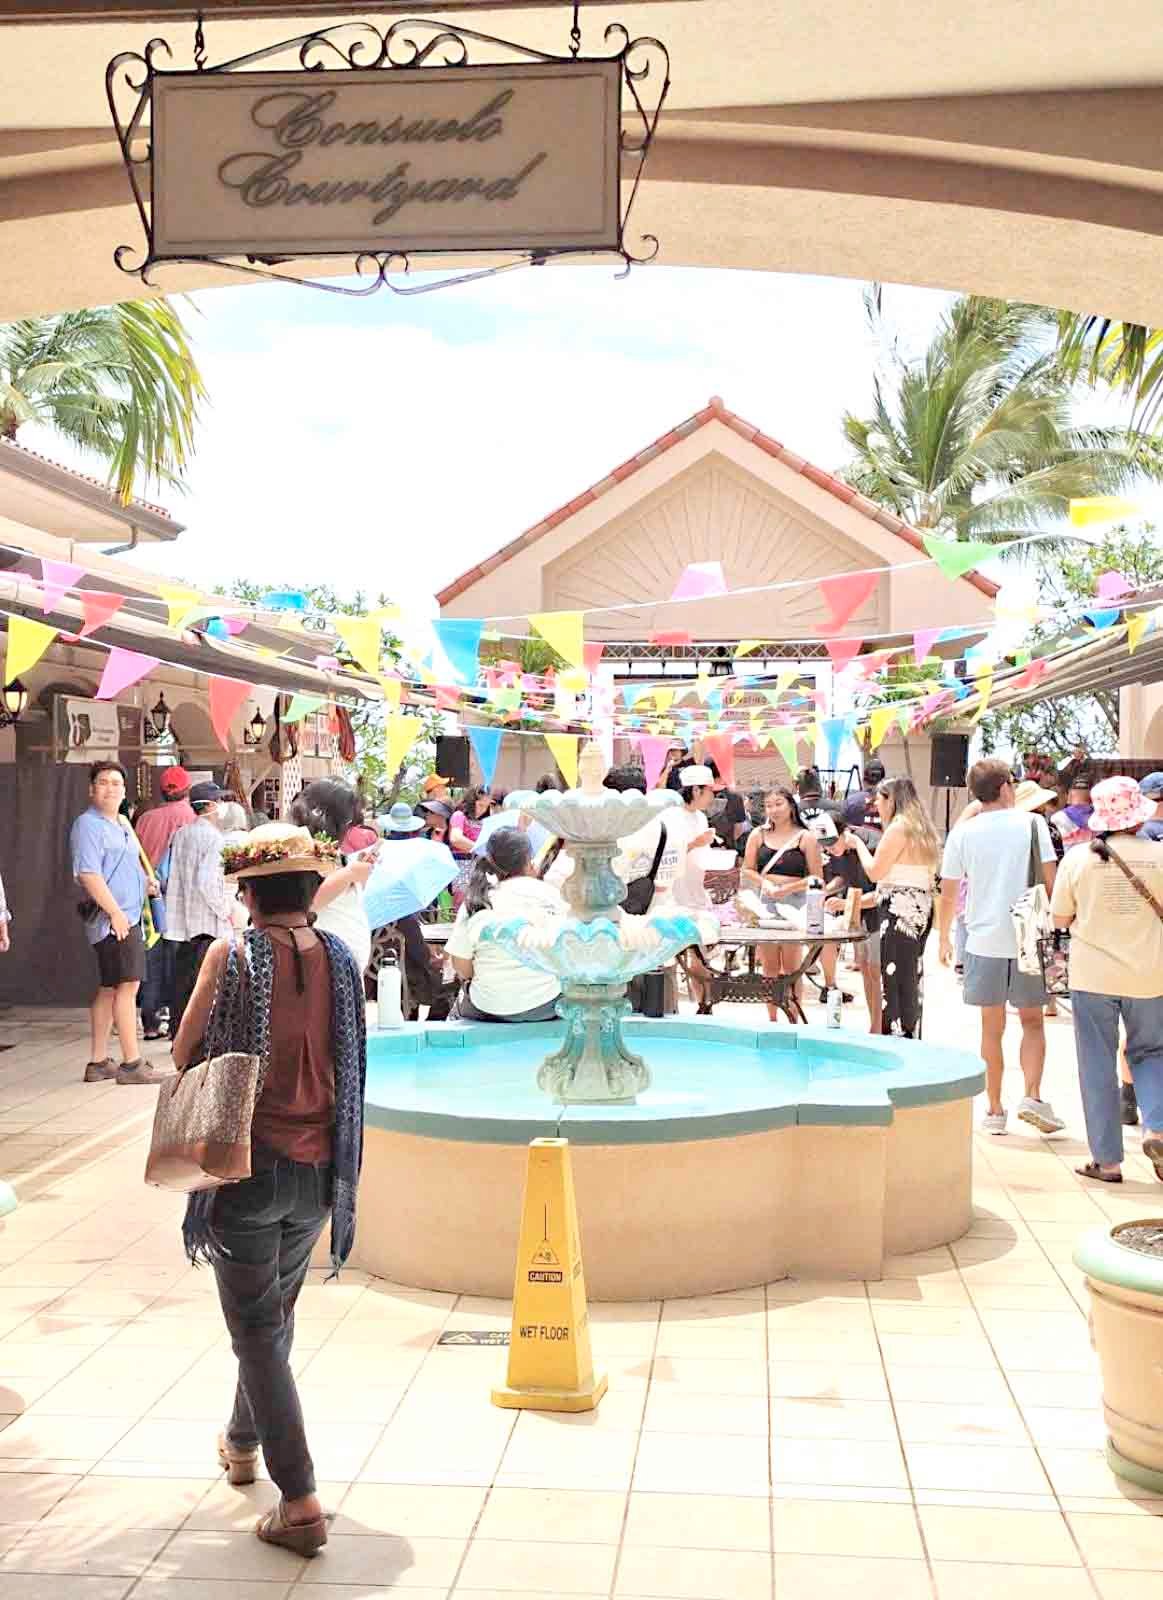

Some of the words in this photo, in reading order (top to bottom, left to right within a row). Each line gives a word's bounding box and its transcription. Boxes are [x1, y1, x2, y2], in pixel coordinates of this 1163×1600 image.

[250, 88, 514, 150] Consuelo
[217, 151, 548, 226] Courtyard
[529, 1272, 562, 1282] CAUTION
[519, 1325, 538, 1339] WET
[540, 1325, 569, 1341] FLOOR
